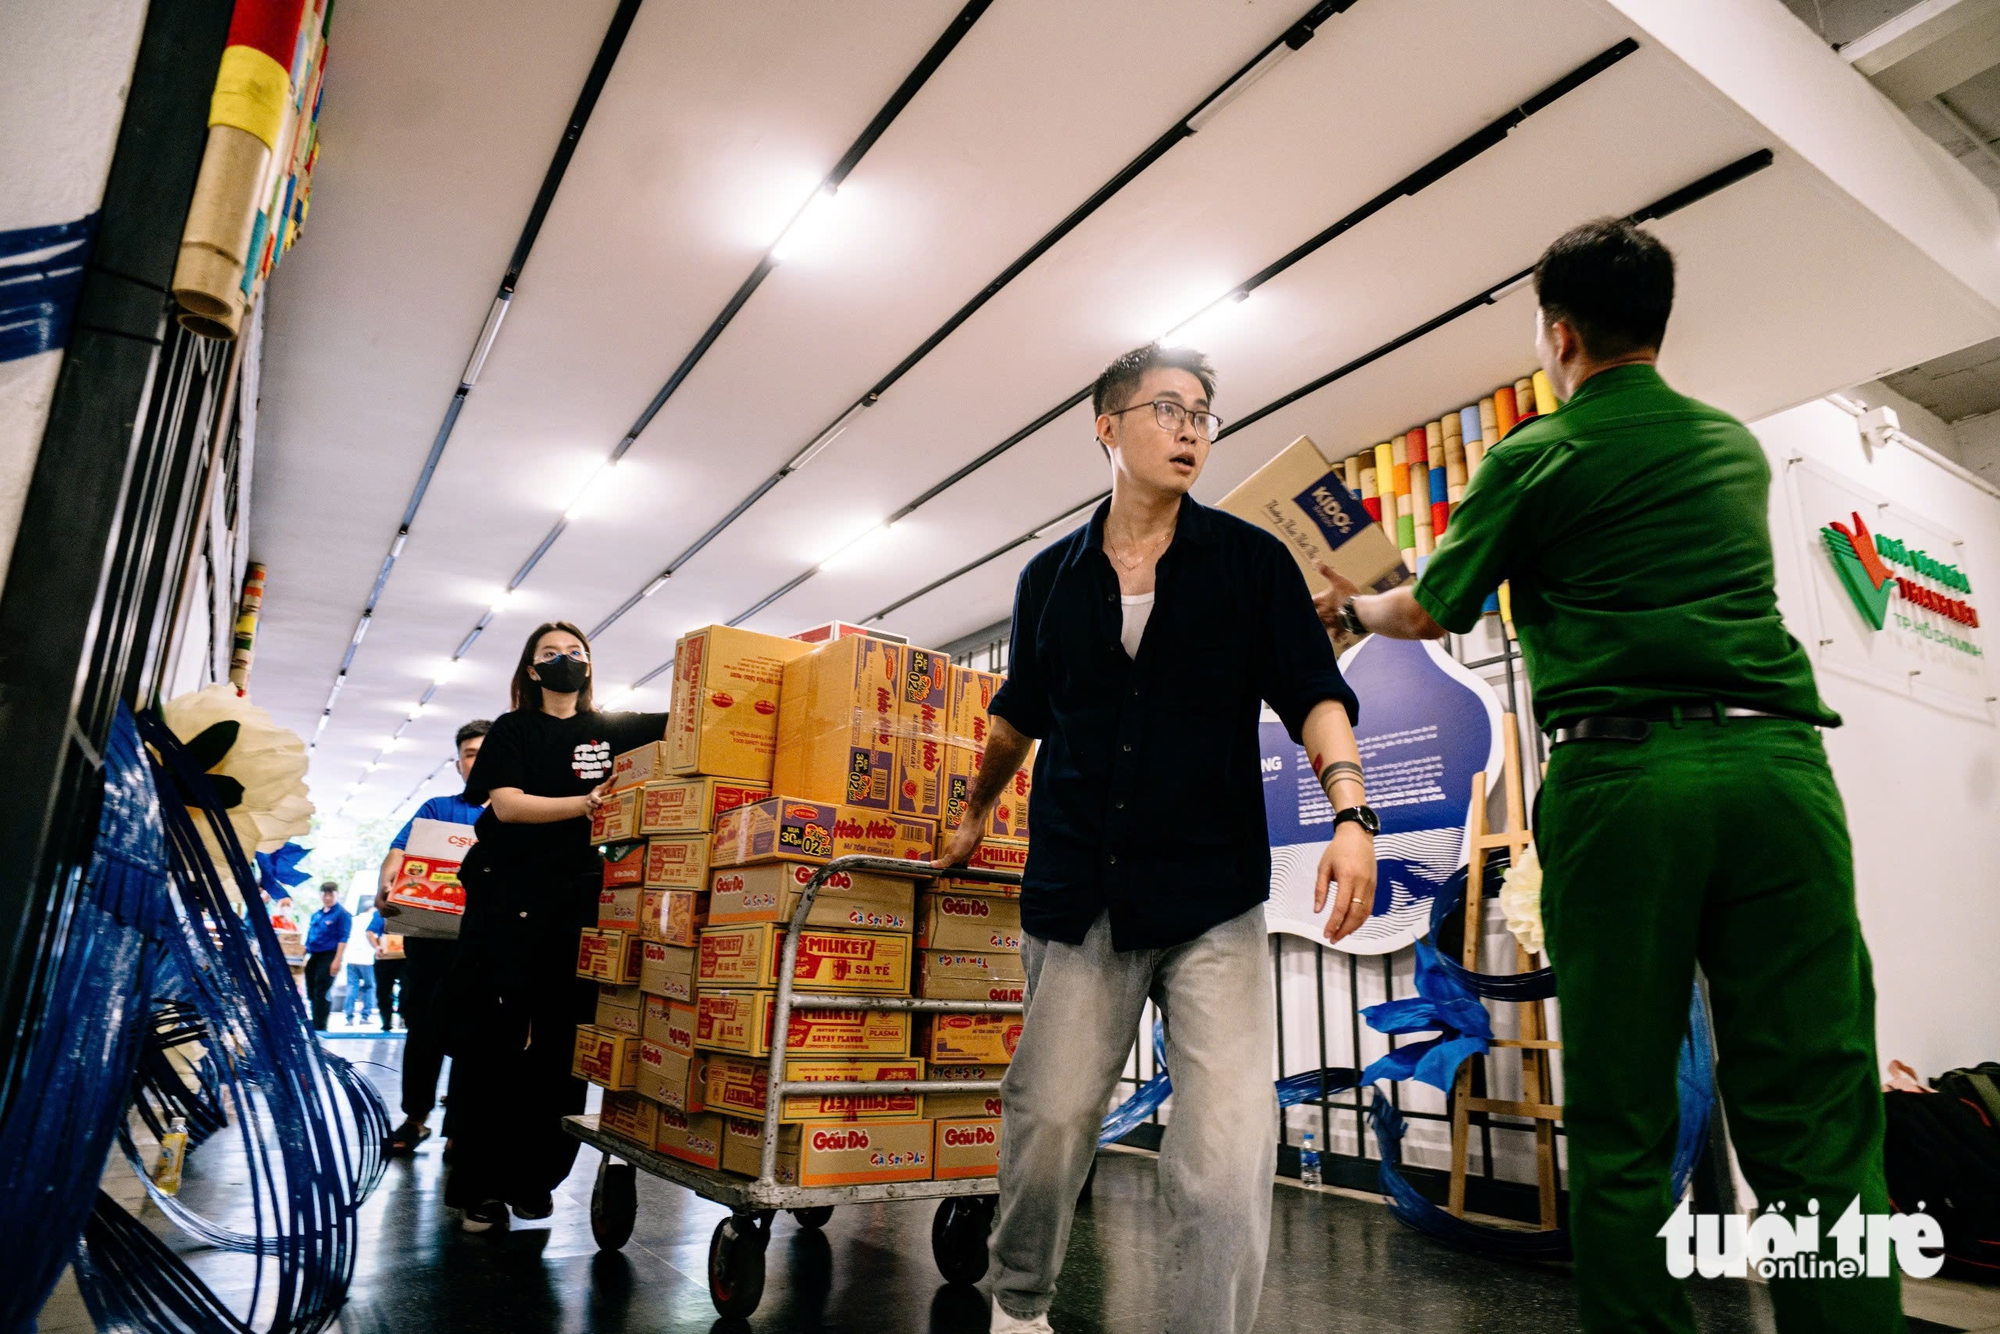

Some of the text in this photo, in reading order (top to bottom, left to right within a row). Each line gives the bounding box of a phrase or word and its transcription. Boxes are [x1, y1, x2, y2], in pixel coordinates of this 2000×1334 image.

[923, 739, 940, 772] Hảo
[1260, 755, 1283, 773] NG
[833, 818, 896, 840] Hảo Hảo
[982, 848, 1028, 864] MILIKE
[942, 897, 989, 917] Gấu Đỏ
[849, 910, 864, 925] Gà
[808, 938, 868, 955] MILIKET
[990, 935, 1003, 948] Gà
[855, 962, 891, 976] SA TẾ
[813, 1130, 869, 1151] Gấu Đỏ
[945, 1126, 995, 1147] Gấu Đỏ
[870, 1153, 885, 1166] Gà
[888, 1153, 903, 1168] Sợi
